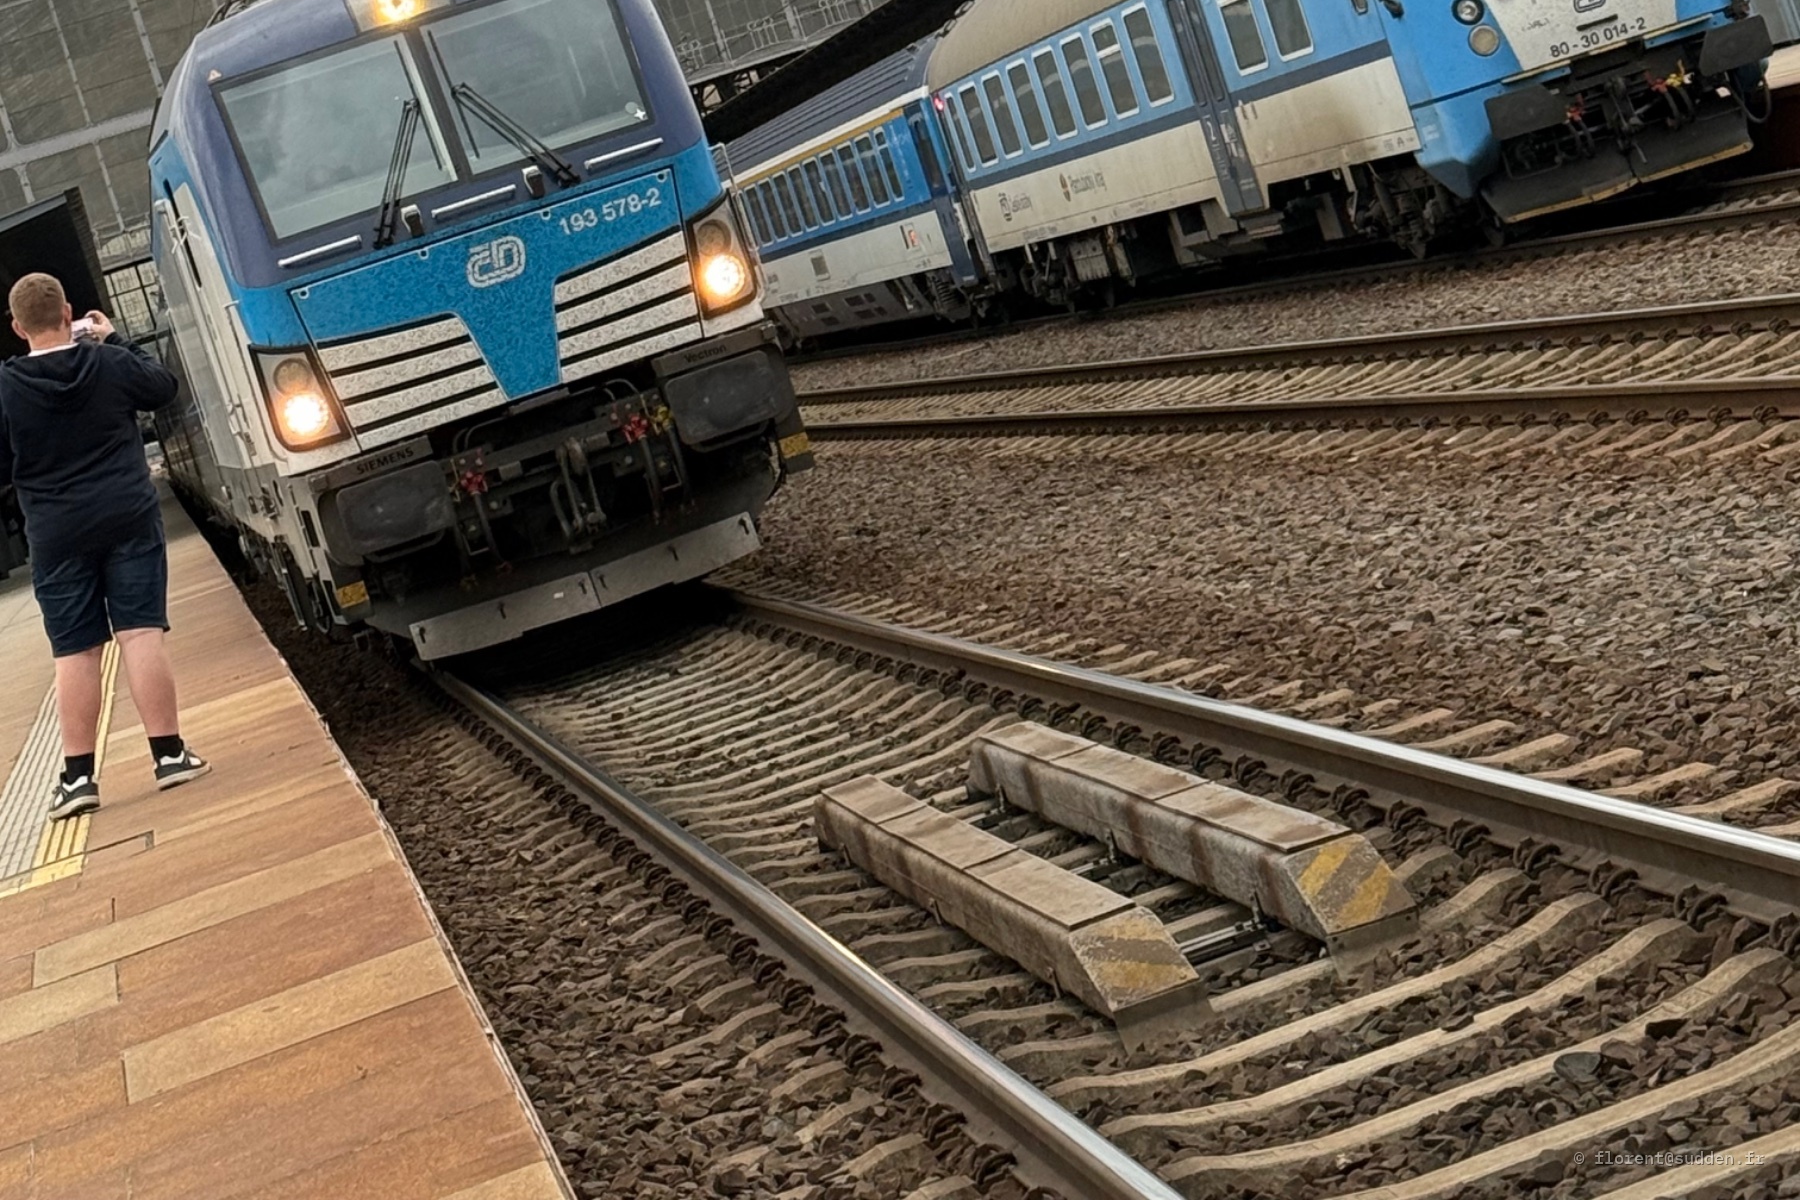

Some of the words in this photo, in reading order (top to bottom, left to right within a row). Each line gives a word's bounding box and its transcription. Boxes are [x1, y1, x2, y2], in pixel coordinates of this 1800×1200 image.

[559, 208, 598, 235] 193
[602, 187, 661, 221] 578-2
[466, 235, 526, 288] ČD
[684, 344, 727, 363] Vectron
[356, 446, 414, 475] SIEMENS
